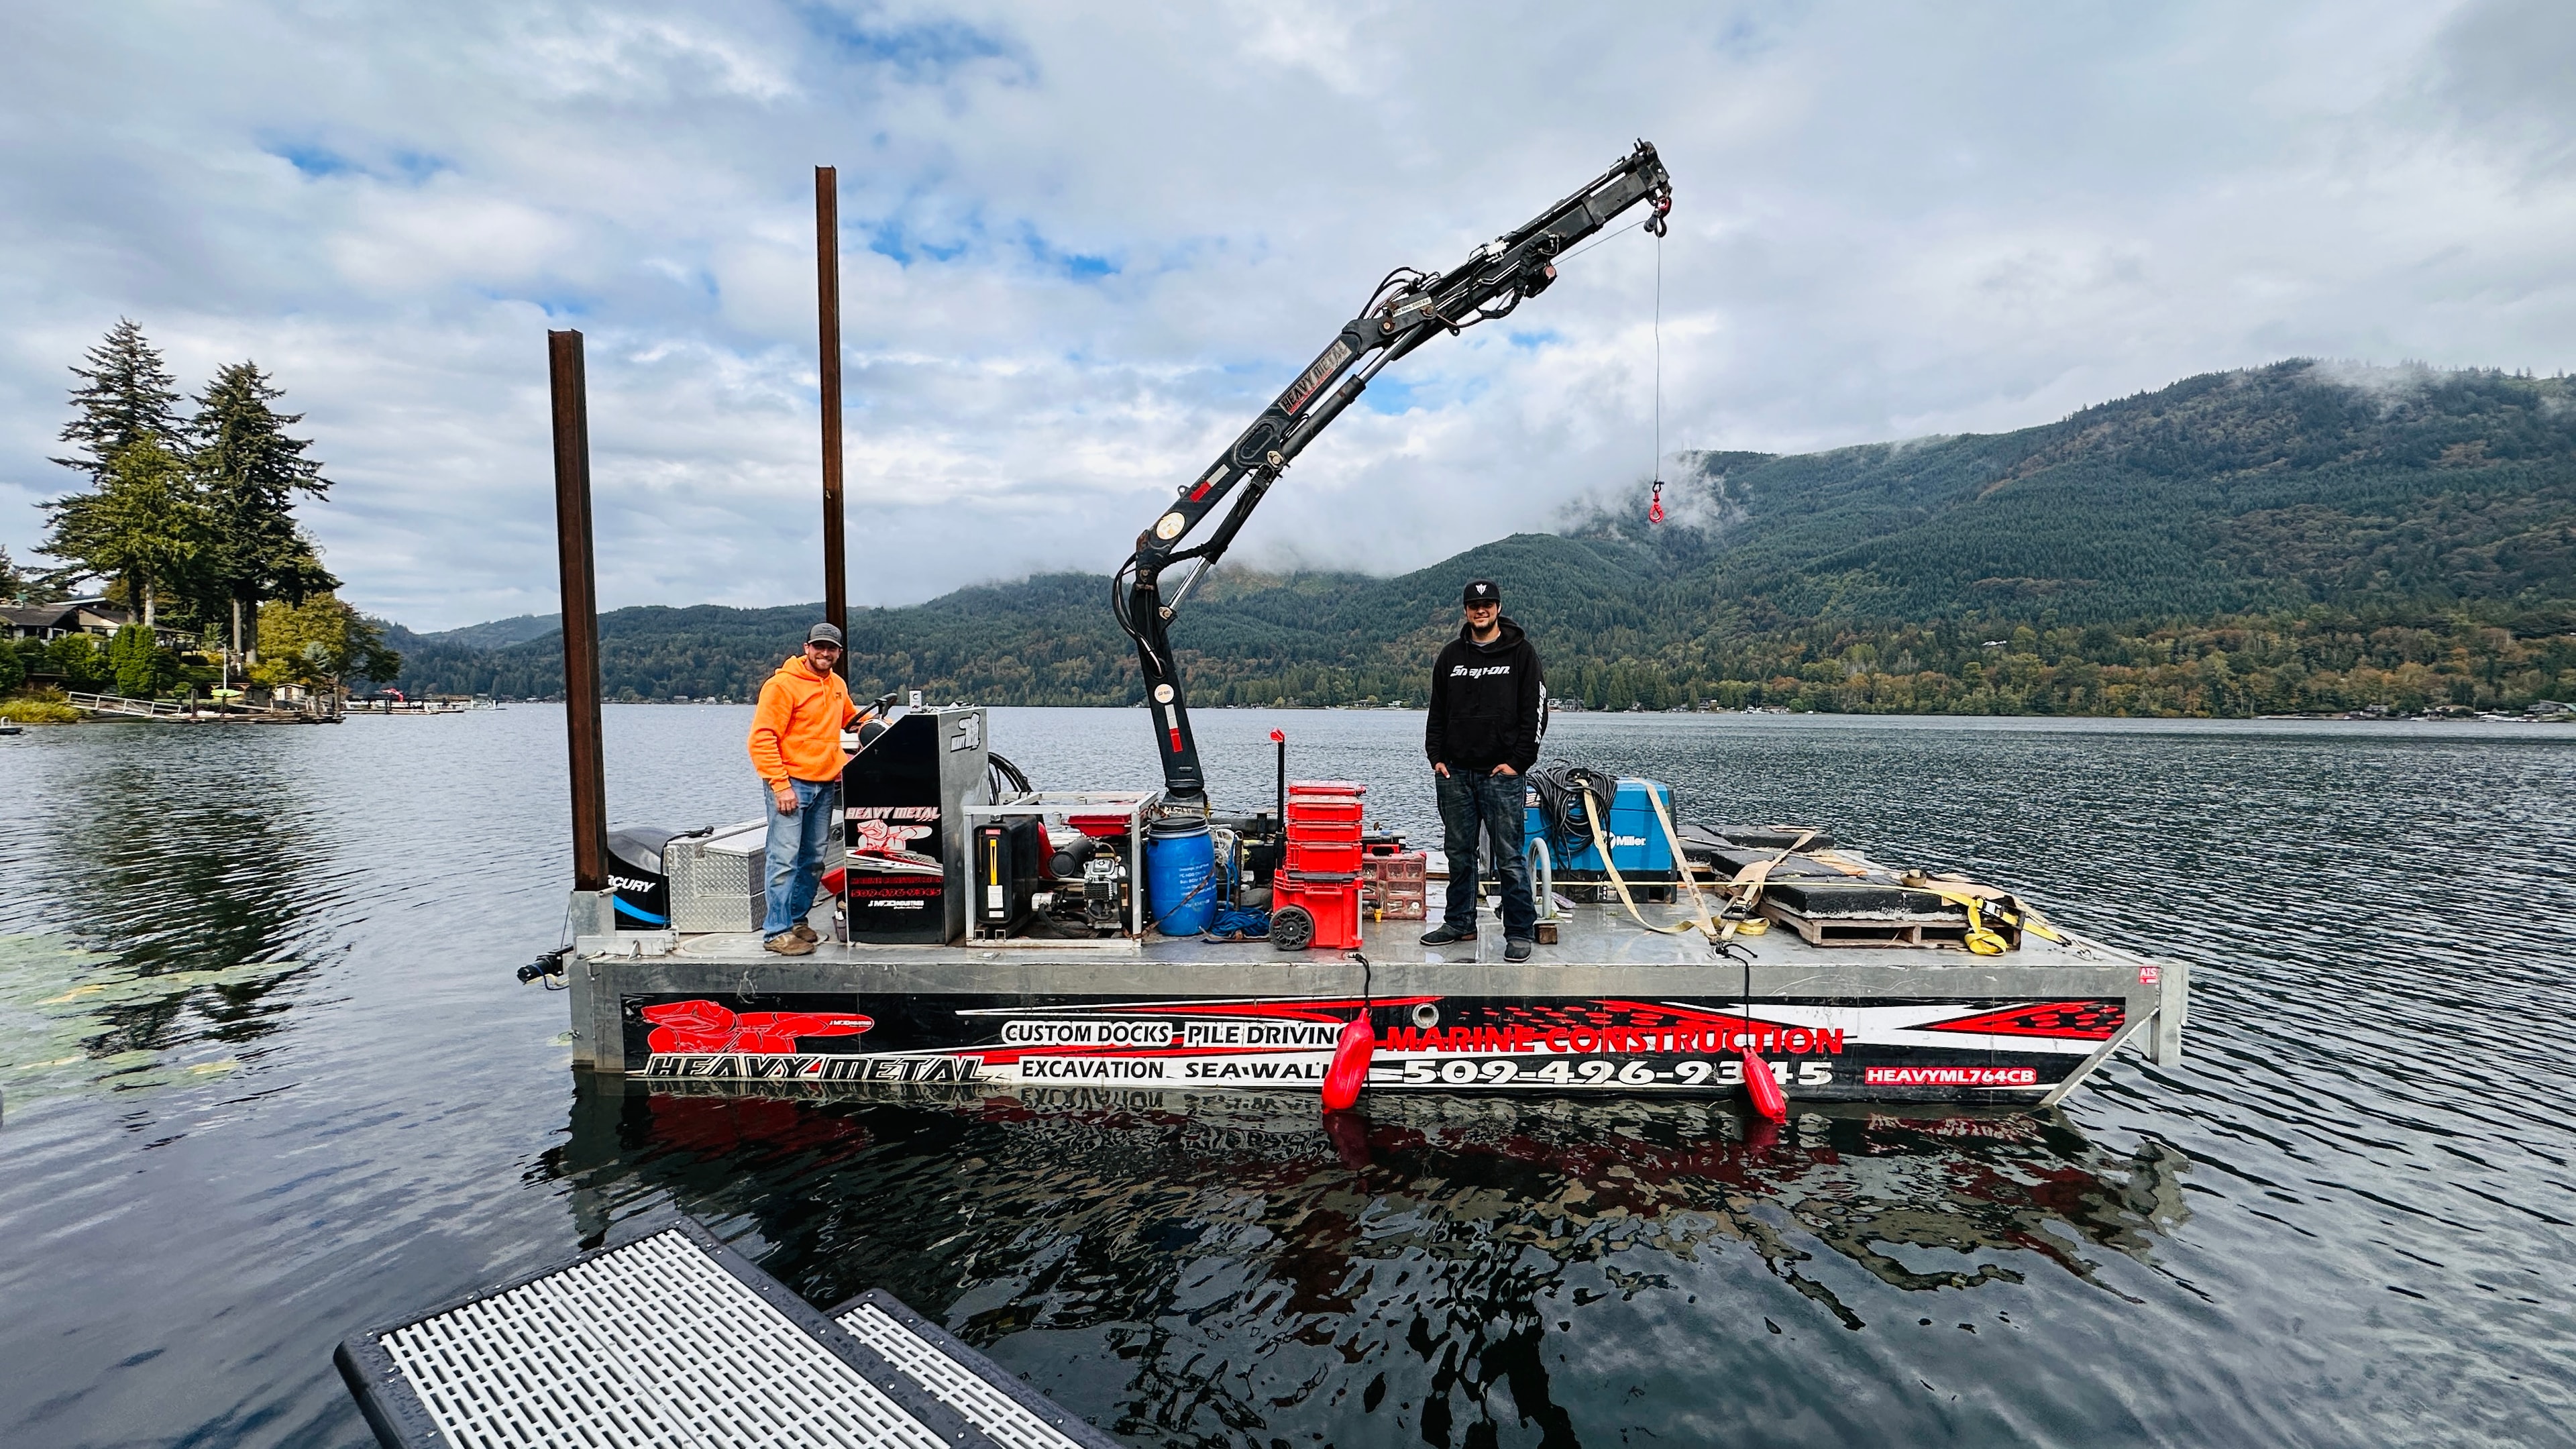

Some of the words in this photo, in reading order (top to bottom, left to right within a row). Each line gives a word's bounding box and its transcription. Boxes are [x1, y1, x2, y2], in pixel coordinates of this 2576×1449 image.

[1280, 370, 1315, 411] HEAVY
[1312, 341, 1349, 380] METAL
[845, 807, 894, 819] HEAVY
[892, 806, 941, 821] METAL
[1616, 836, 1646, 846] Miller
[608, 875, 657, 892] RCURY
[2140, 967, 2157, 977] AIS
[1006, 1024, 1091, 1042] CUSTOM
[1097, 1025, 1169, 1043] DOCKS
[1187, 1026, 1243, 1044] PILE
[1386, 1026, 1535, 1053] MARINE
[1545, 1026, 1843, 1055] CONSTRUCTION
[648, 1055, 812, 1079] HEAVY
[820, 1056, 989, 1082] METAL
[1022, 1060, 1165, 1079] EXCAVATION
[1867, 1069, 2035, 1083] HEAVYML764CB
